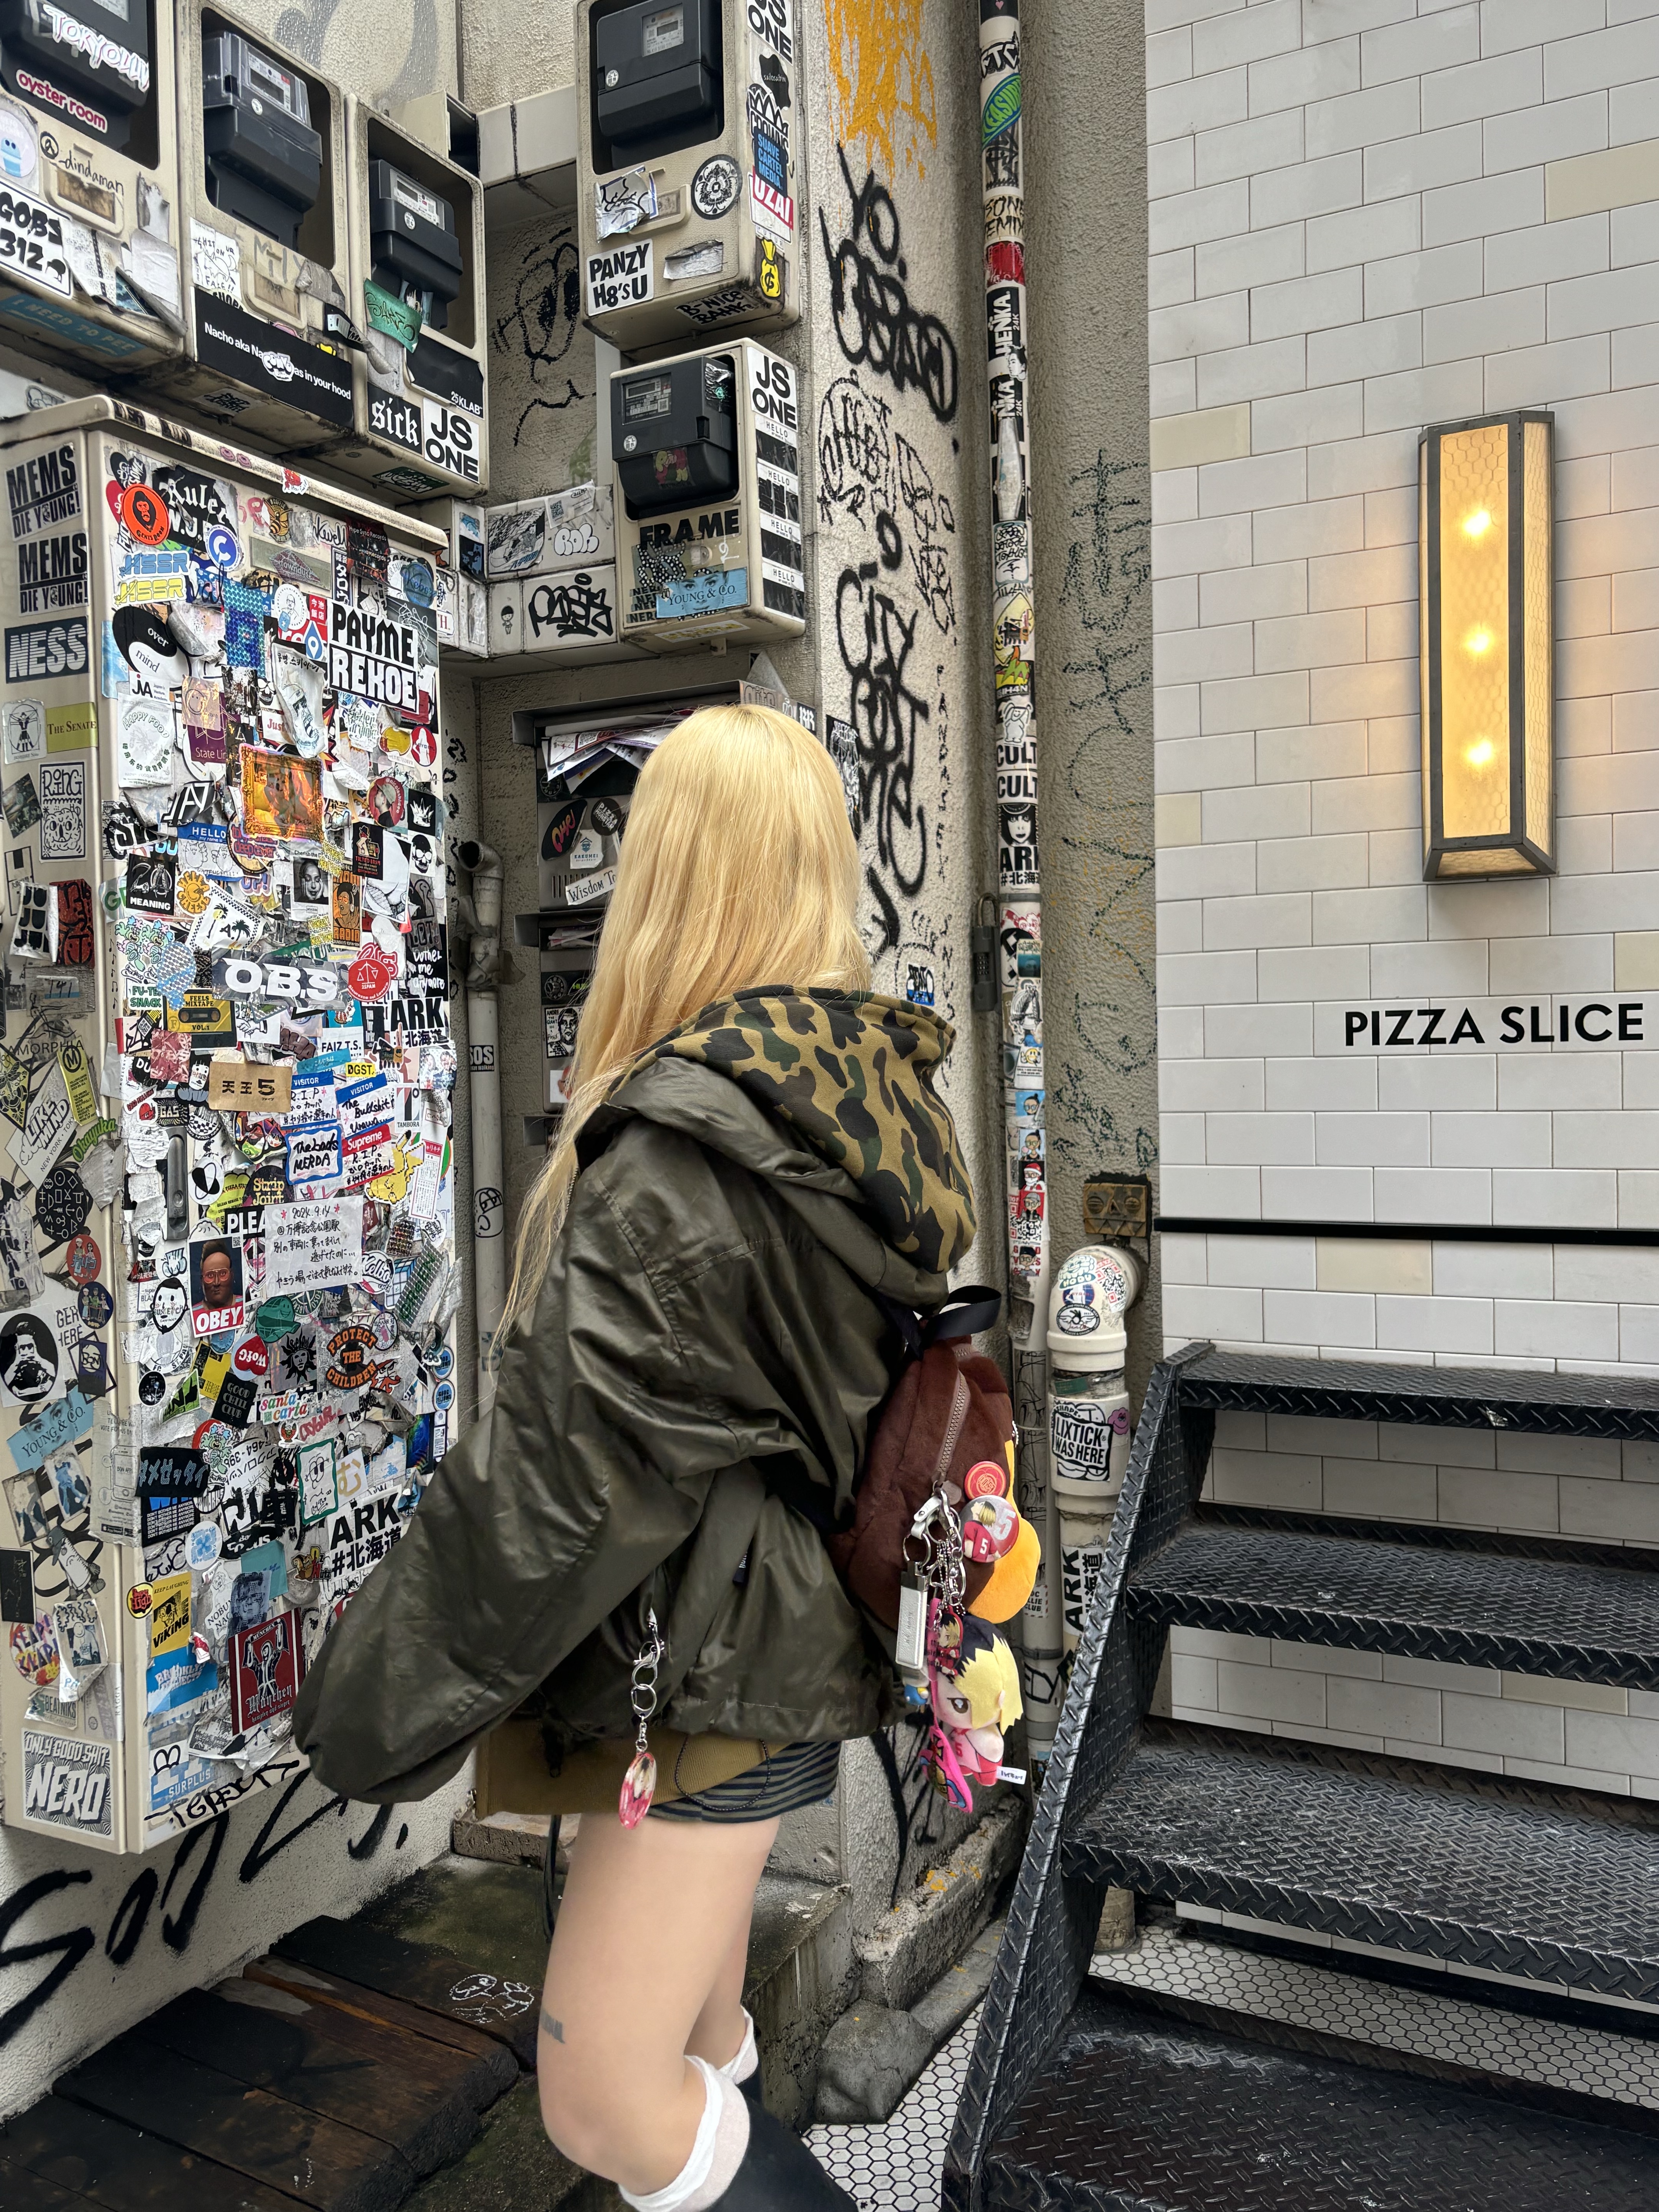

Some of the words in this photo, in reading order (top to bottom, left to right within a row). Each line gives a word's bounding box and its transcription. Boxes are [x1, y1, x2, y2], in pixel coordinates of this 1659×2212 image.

[750, 12, 793, 62] ONE
[19, 72, 66, 108] oyster
[69, 100, 105, 130] room
[758, 134, 779, 156] SUAVE
[758, 147, 783, 178] CARTEL
[754, 175, 790, 225] UZAI
[589, 243, 650, 283] PANZY
[632, 273, 647, 297] U
[204, 322, 234, 345] Nacho
[235, 339, 250, 352] aka
[304, 369, 313, 382] in
[313, 374, 331, 390] your
[332, 381, 351, 400] hood
[756, 355, 791, 399] JS
[752, 387, 797, 431] ONE
[1015, 399, 1023, 417] 24K
[371, 398, 420, 447] sick
[431, 409, 472, 451] JS
[766, 420, 788, 439] HELLO
[426, 438, 479, 482] ONE
[6, 445, 76, 509] MEMS
[768, 469, 790, 487] HELLO
[12, 512, 32, 539] DIE
[369, 530, 387, 541] Records
[640, 508, 739, 550] FRAME
[771, 519, 792, 536] HELLO
[19, 532, 88, 584] MEMS
[773, 568, 795, 583] HELLO
[21, 587, 38, 613] DIE
[311, 598, 325, 609] 今池
[707, 588, 716, 598] &
[311, 608, 325, 620] 飯店
[147, 626, 169, 648] over
[332, 602, 413, 663] PAYME
[9, 624, 86, 678] NESS
[136, 649, 161, 673] mind
[331, 646, 416, 710] REKOE
[124, 712, 149, 731] HAPPY
[148, 715, 170, 737] FOOD
[196, 747, 215, 758] State
[599, 802, 618, 824] PIZZA
[192, 826, 227, 839] HELLO
[130, 896, 171, 911] MEANING
[333, 927, 360, 941] RADIO
[418, 963, 433, 975] me
[413, 975, 445, 998] anymore
[130, 997, 162, 1008] SNACK
[391, 998, 444, 1032] ARK
[1345, 1007, 1486, 1046] PIZZA
[1499, 1003, 1644, 1044] SLICE
[9, 1039, 84, 1056] AMORPHIA
[321, 1041, 341, 1052] FAIZ
[294, 1077, 319, 1086] VISITOR
[350, 1082, 374, 1096] VISITOR
[26, 1100, 57, 1146] LIKE
[41, 1098, 70, 1150] MIND
[160, 1106, 180, 1118] GAS
[72, 1117, 116, 1161] Okayuka
[347, 1131, 382, 1152] Supreme
[41, 1155, 52, 1172] NEW
[50, 1139, 62, 1157] YORK
[253, 1178, 285, 1192] Strip
[252, 1191, 284, 1206] Joint
[1063, 1273, 1092, 1287] HODU
[196, 1305, 242, 1333] OBEY
[329, 1328, 377, 1354] PROTECT
[238, 1348, 266, 1367] WofG
[342, 1350, 361, 1364] THE
[327, 1363, 377, 1388] CHILDREN
[227, 1382, 250, 1398] GOOD
[221, 1404, 242, 1418] CLUB
[260, 1393, 297, 1412] santa
[273, 1402, 307, 1421] carta
[57, 1418, 68, 1432] &
[1055, 1418, 1101, 1447] LIXTICK
[1055, 1435, 1075, 1458] WAS
[1075, 1441, 1105, 1465] HERE
[331, 1492, 401, 1550] ARK
[994, 1510, 1016, 1541] 5
[979, 1538, 988, 1555] 5
[153, 1586, 166, 1594] KEEP
[166, 1580, 189, 1590] LAUGHING
[1062, 1546, 1084, 1633] ARK
[45, 1695, 76, 1719] BEATNIKS
[26, 1734, 51, 1759] ONLY
[51, 1739, 82, 1762] GOOD
[82, 1744, 109, 1768] SHIT
[27, 1762, 109, 1825] NERO
[169, 1769, 211, 1798] SURPLUS
